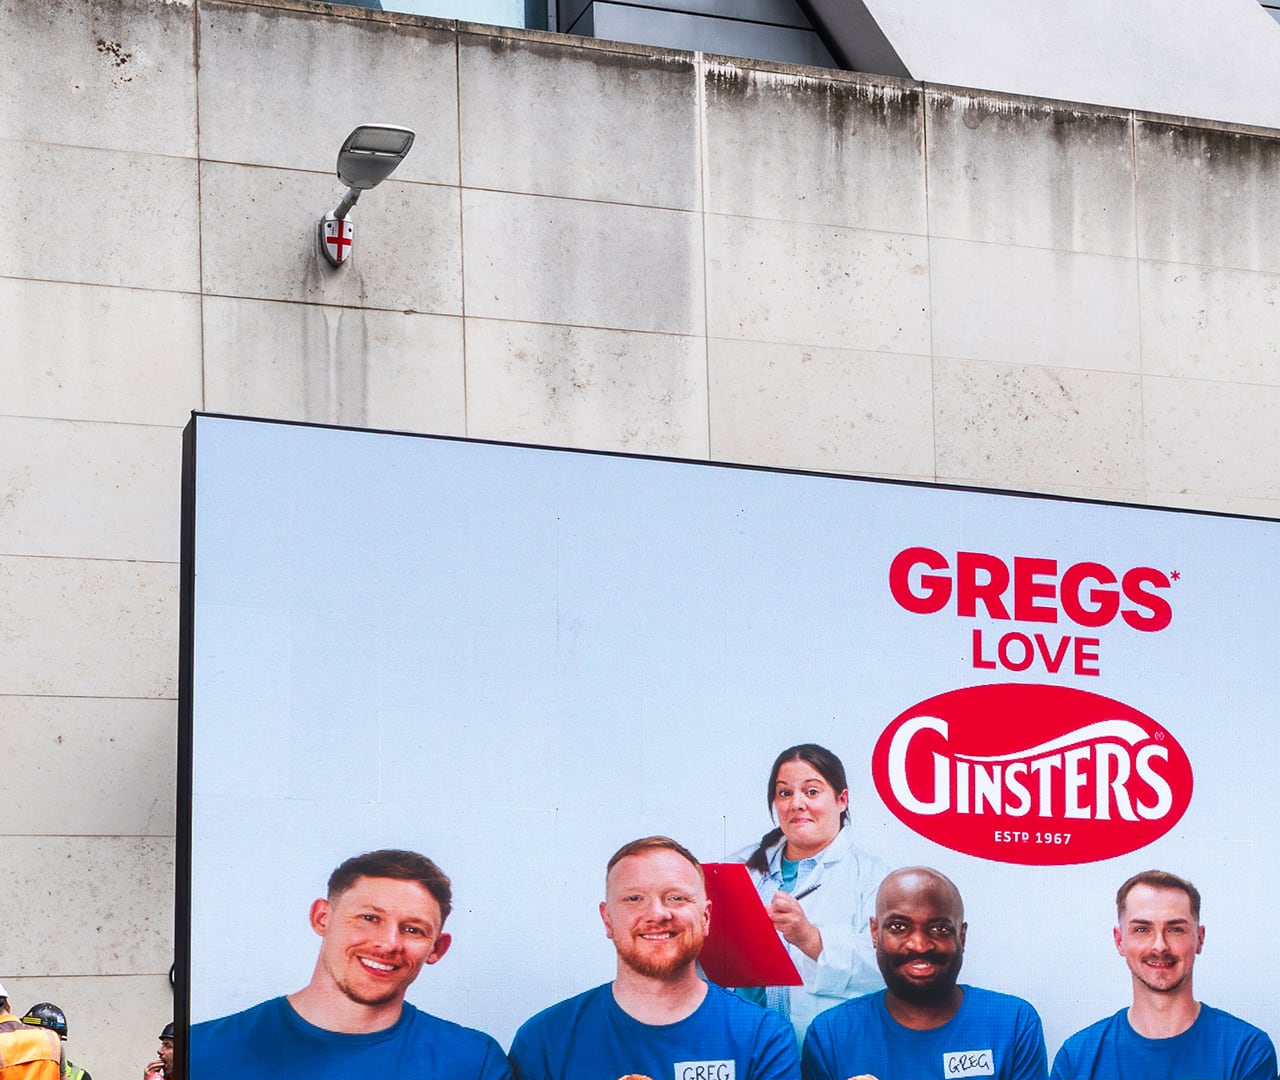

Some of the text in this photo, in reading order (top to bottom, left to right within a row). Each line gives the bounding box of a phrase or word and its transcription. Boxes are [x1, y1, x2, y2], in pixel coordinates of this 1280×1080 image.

[972, 629, 1100, 677] LOVE
[887, 715, 1174, 822] GINSTERS
[1035, 832, 1072, 845] 1967
[948, 1053, 990, 1074] GREG
